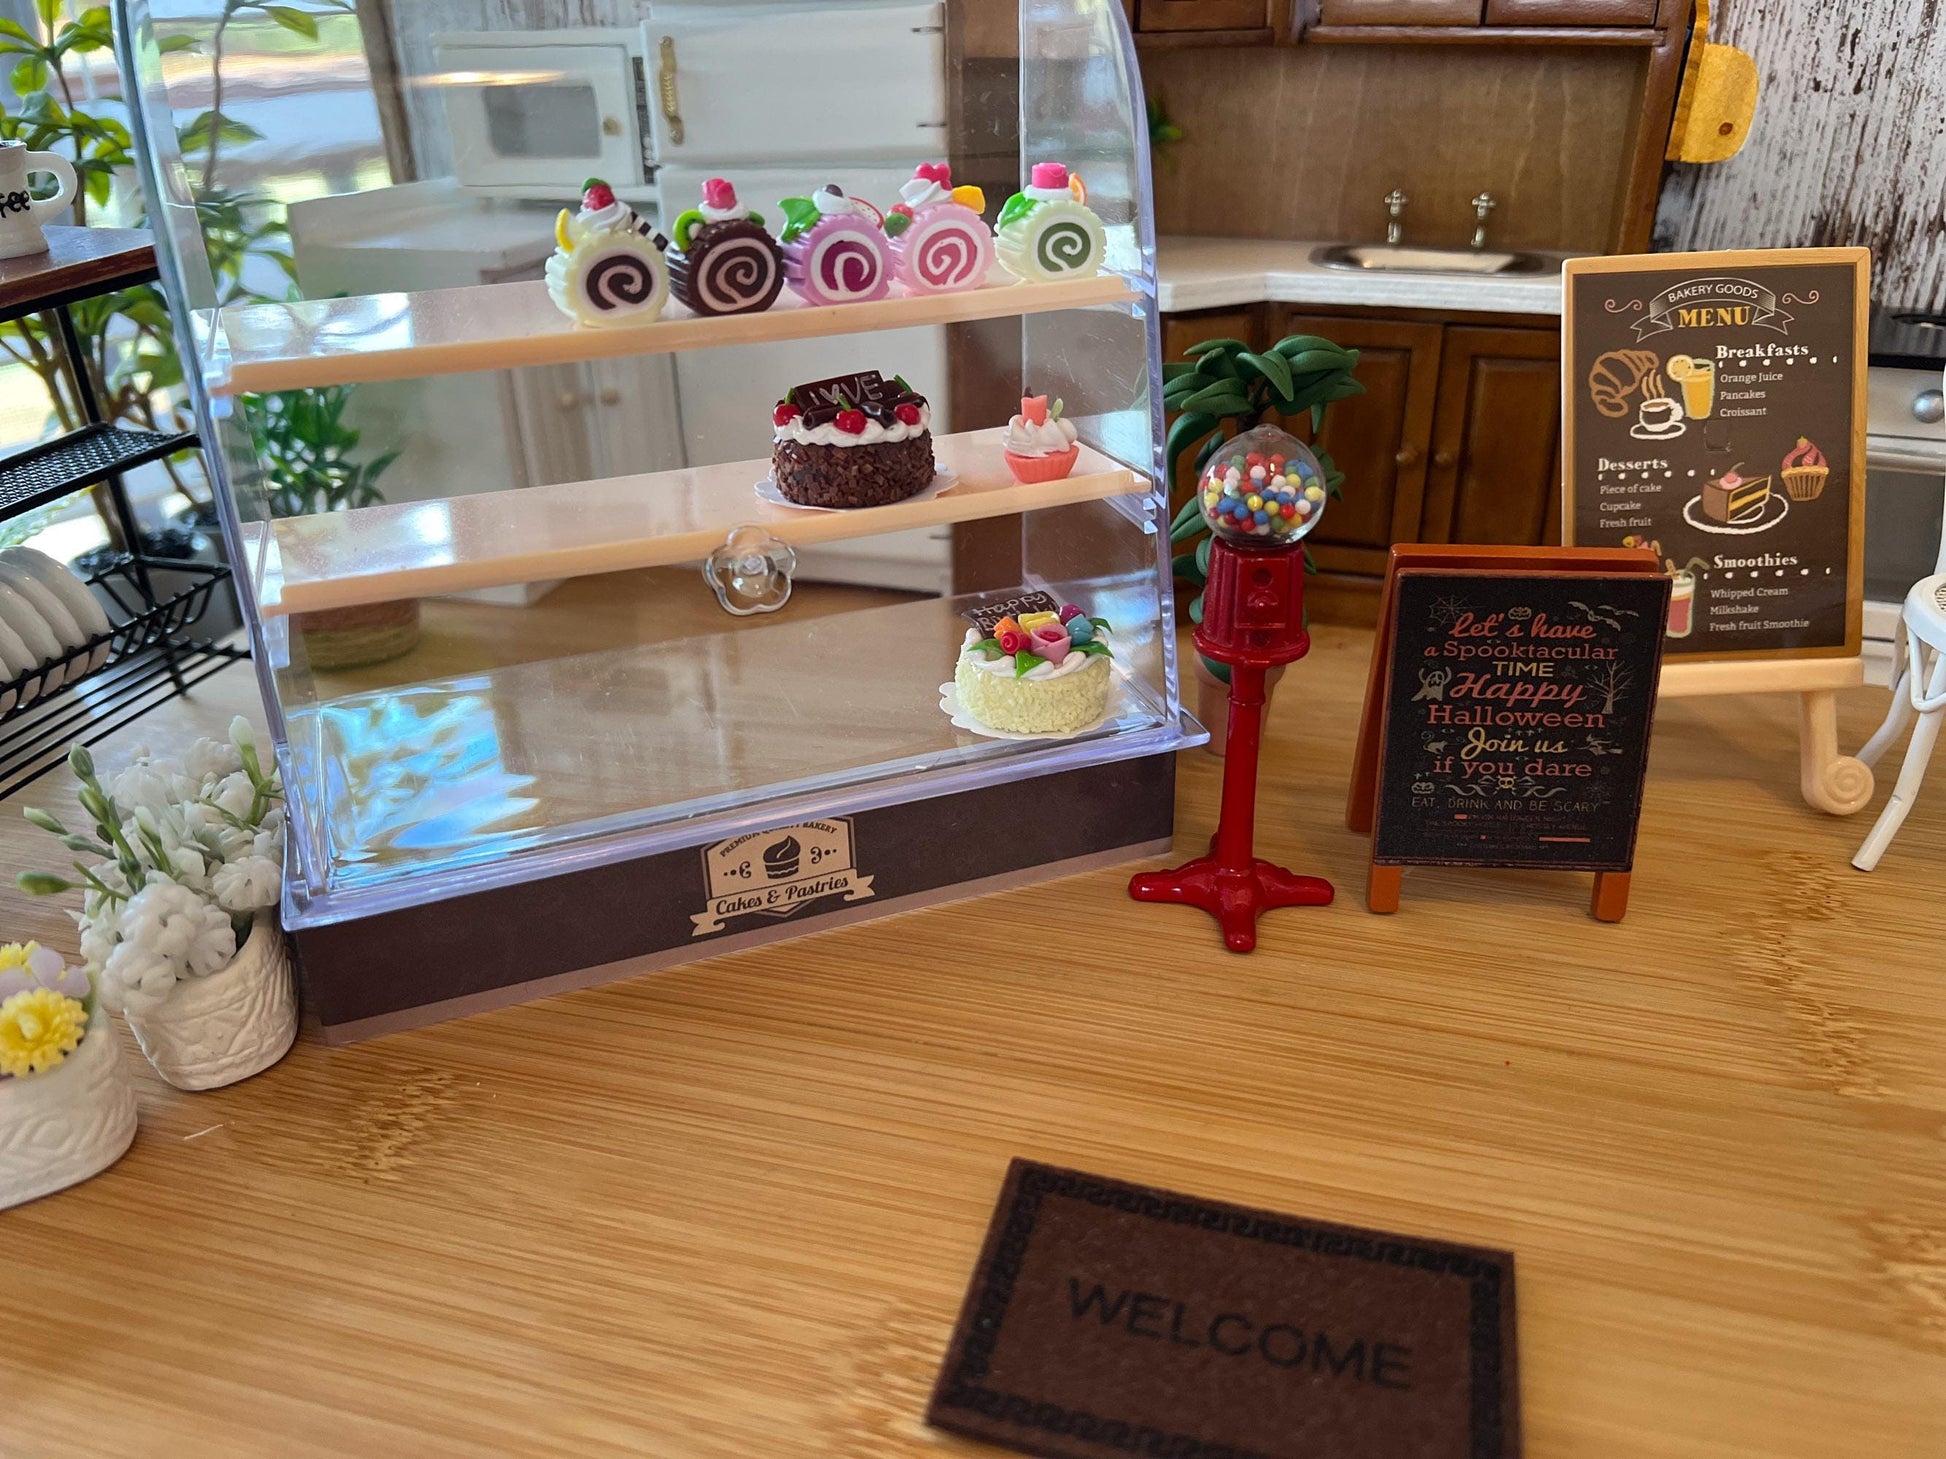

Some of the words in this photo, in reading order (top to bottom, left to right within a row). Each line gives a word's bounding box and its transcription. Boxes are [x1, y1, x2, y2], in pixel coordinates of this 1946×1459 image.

[1668, 284, 1713, 302] BAKERY
[1715, 284, 1759, 299] GOODS
[1678, 306, 1751, 328] MENU
[1715, 344, 1809, 359] Breakfasts
[1720, 372, 1756, 384] Orange
[1758, 372, 1783, 383] Juice
[1720, 390, 1766, 400] Pancakes
[1720, 406, 1767, 417] Croissant
[1597, 458, 1668, 472] Desserts
[1600, 484, 1626, 494] Piece
[1627, 484, 1637, 493] of
[1639, 483, 1662, 492] cake
[1600, 500, 1642, 512] Cupcake
[1600, 518, 1627, 528] Fresh
[1629, 517, 1652, 527] fruit
[1713, 552, 1798, 569] Smoothies
[1710, 588, 1753, 600] Whipped
[1754, 587, 1788, 597] Cream
[973, 594, 1047, 616] Happy
[1710, 604, 1760, 615] Milkshake
[1449, 612, 1524, 638] Let's
[1530, 612, 1598, 639] have
[1709, 622, 1736, 632] Fresh
[1738, 620, 1761, 630] fruit
[1762, 618, 1810, 630] Smoothie
[1424, 646, 1439, 658] a
[1443, 642, 1619, 661] Spooktacular
[1492, 661, 1556, 678] TIME
[1449, 672, 1588, 706] Happy
[1427, 704, 1606, 728] Halloween
[1460, 727, 1529, 760] Join
[1534, 740, 1568, 754] us
[1432, 756, 1452, 774] if
[1462, 760, 1516, 778] you
[1524, 759, 1592, 778] dare
[1448, 798, 1490, 810] DRINK
[1494, 799, 1522, 811] AND
[1528, 800, 1547, 812] BE
[1553, 801, 1600, 812] SCARY
[803, 821, 837, 834] BAKERY
[715, 895, 762, 915] Cakes
[767, 889, 781, 904] &
[785, 877, 849, 900] Pastries
[1067, 1275, 1414, 1391] WELCOME
